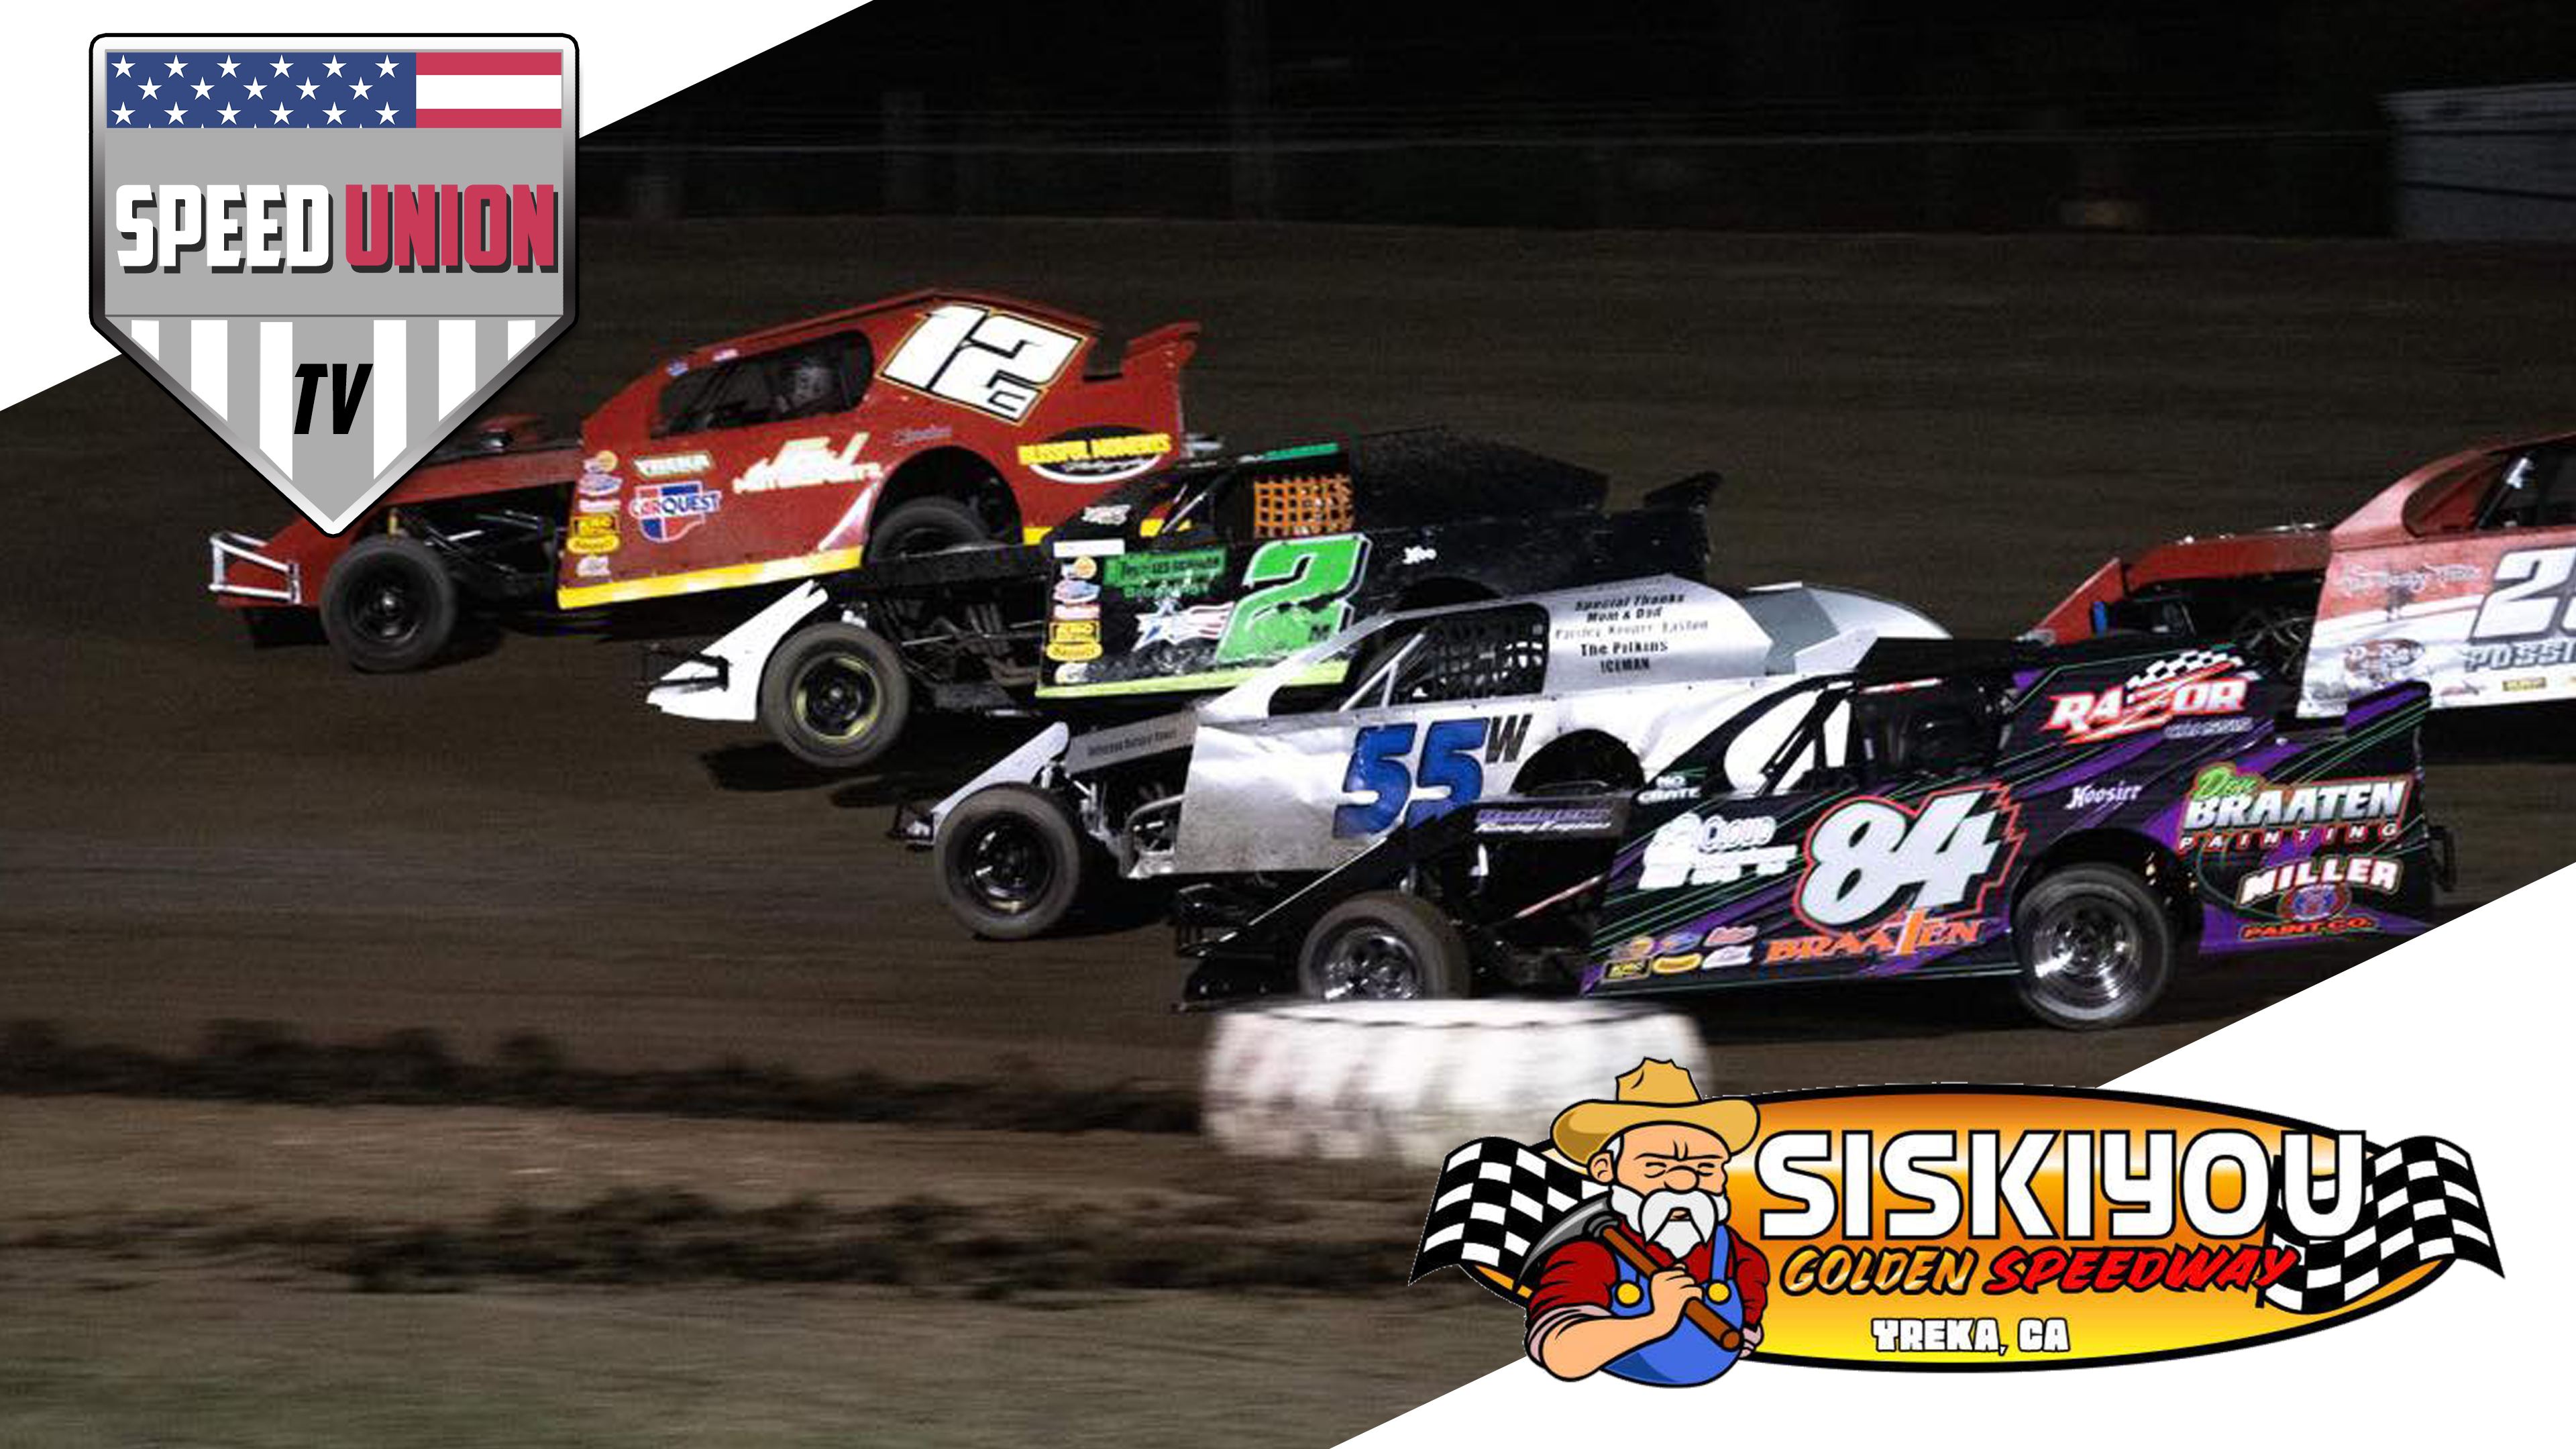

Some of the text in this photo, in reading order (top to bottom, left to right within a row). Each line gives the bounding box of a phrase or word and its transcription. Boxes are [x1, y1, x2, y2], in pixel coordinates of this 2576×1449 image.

[629, 490, 723, 517] CARQUEST
[1214, 533, 1373, 663] 2
[1575, 594, 1685, 611] Special Thanks
[2471, 545, 2576, 643] 2
[1622, 610, 1630, 621] &
[1580, 643, 1608, 657] The
[1600, 657, 1650, 674] ICEMAN
[2043, 678, 2249, 743] RAZOR
[1637, 786, 1702, 804] CRATE
[1655, 775, 1686, 790] NO
[2182, 780, 2407, 830] BRAATEN
[2180, 822, 2398, 850] PAINTING
[1798, 789, 2002, 927] 84
[2239, 856, 2400, 906] MILLER
[1764, 908, 1984, 964] BRAATEN
